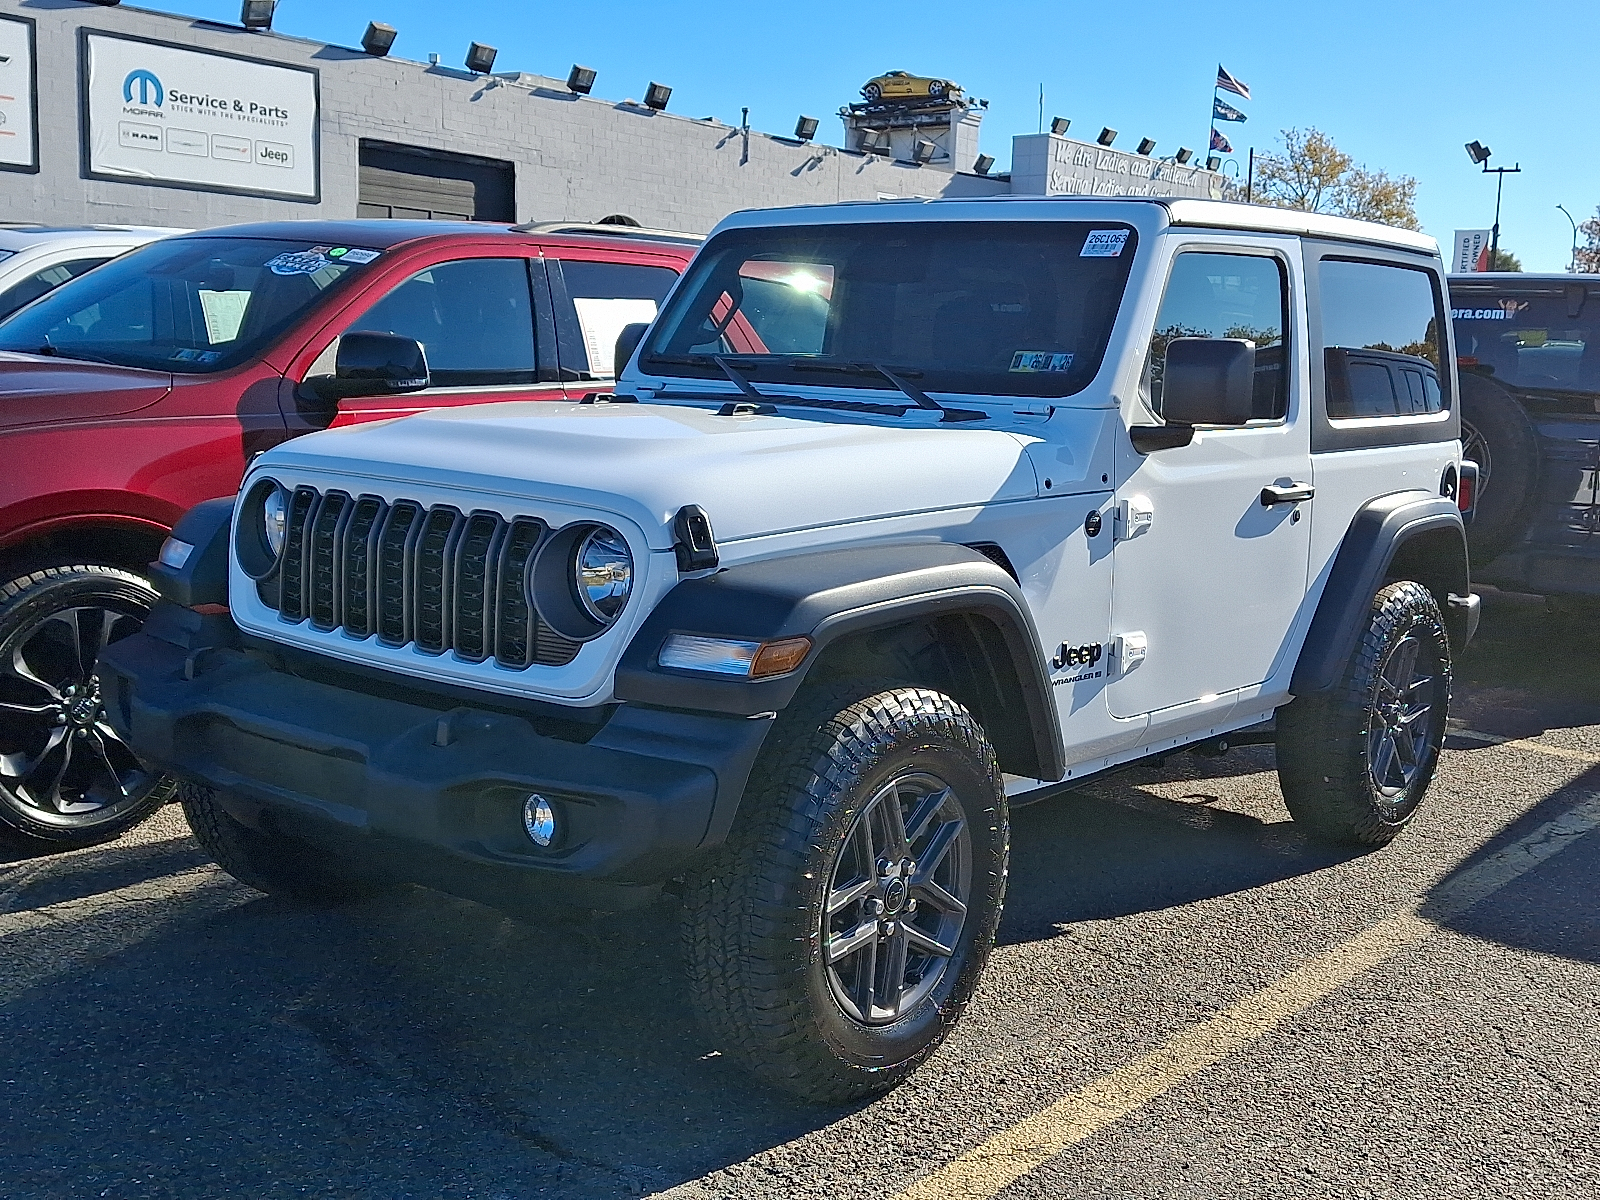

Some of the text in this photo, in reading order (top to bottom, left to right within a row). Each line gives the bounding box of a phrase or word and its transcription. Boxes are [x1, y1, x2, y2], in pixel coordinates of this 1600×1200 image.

[168, 89, 289, 119] Service & Parts
[170, 104, 194, 114] STICK
[197, 108, 217, 117] WITH
[220, 111, 234, 119] THE
[122, 107, 164, 118] MOPAR
[132, 132, 159, 140] RAM
[260, 146, 288, 163] Jeep
[1055, 141, 1198, 187] We Are Ladies and Gentlemen
[1089, 234, 1128, 244] 26C1063
[1053, 640, 1102, 669] Jeep
[1052, 671, 1094, 687] WRANGLER
